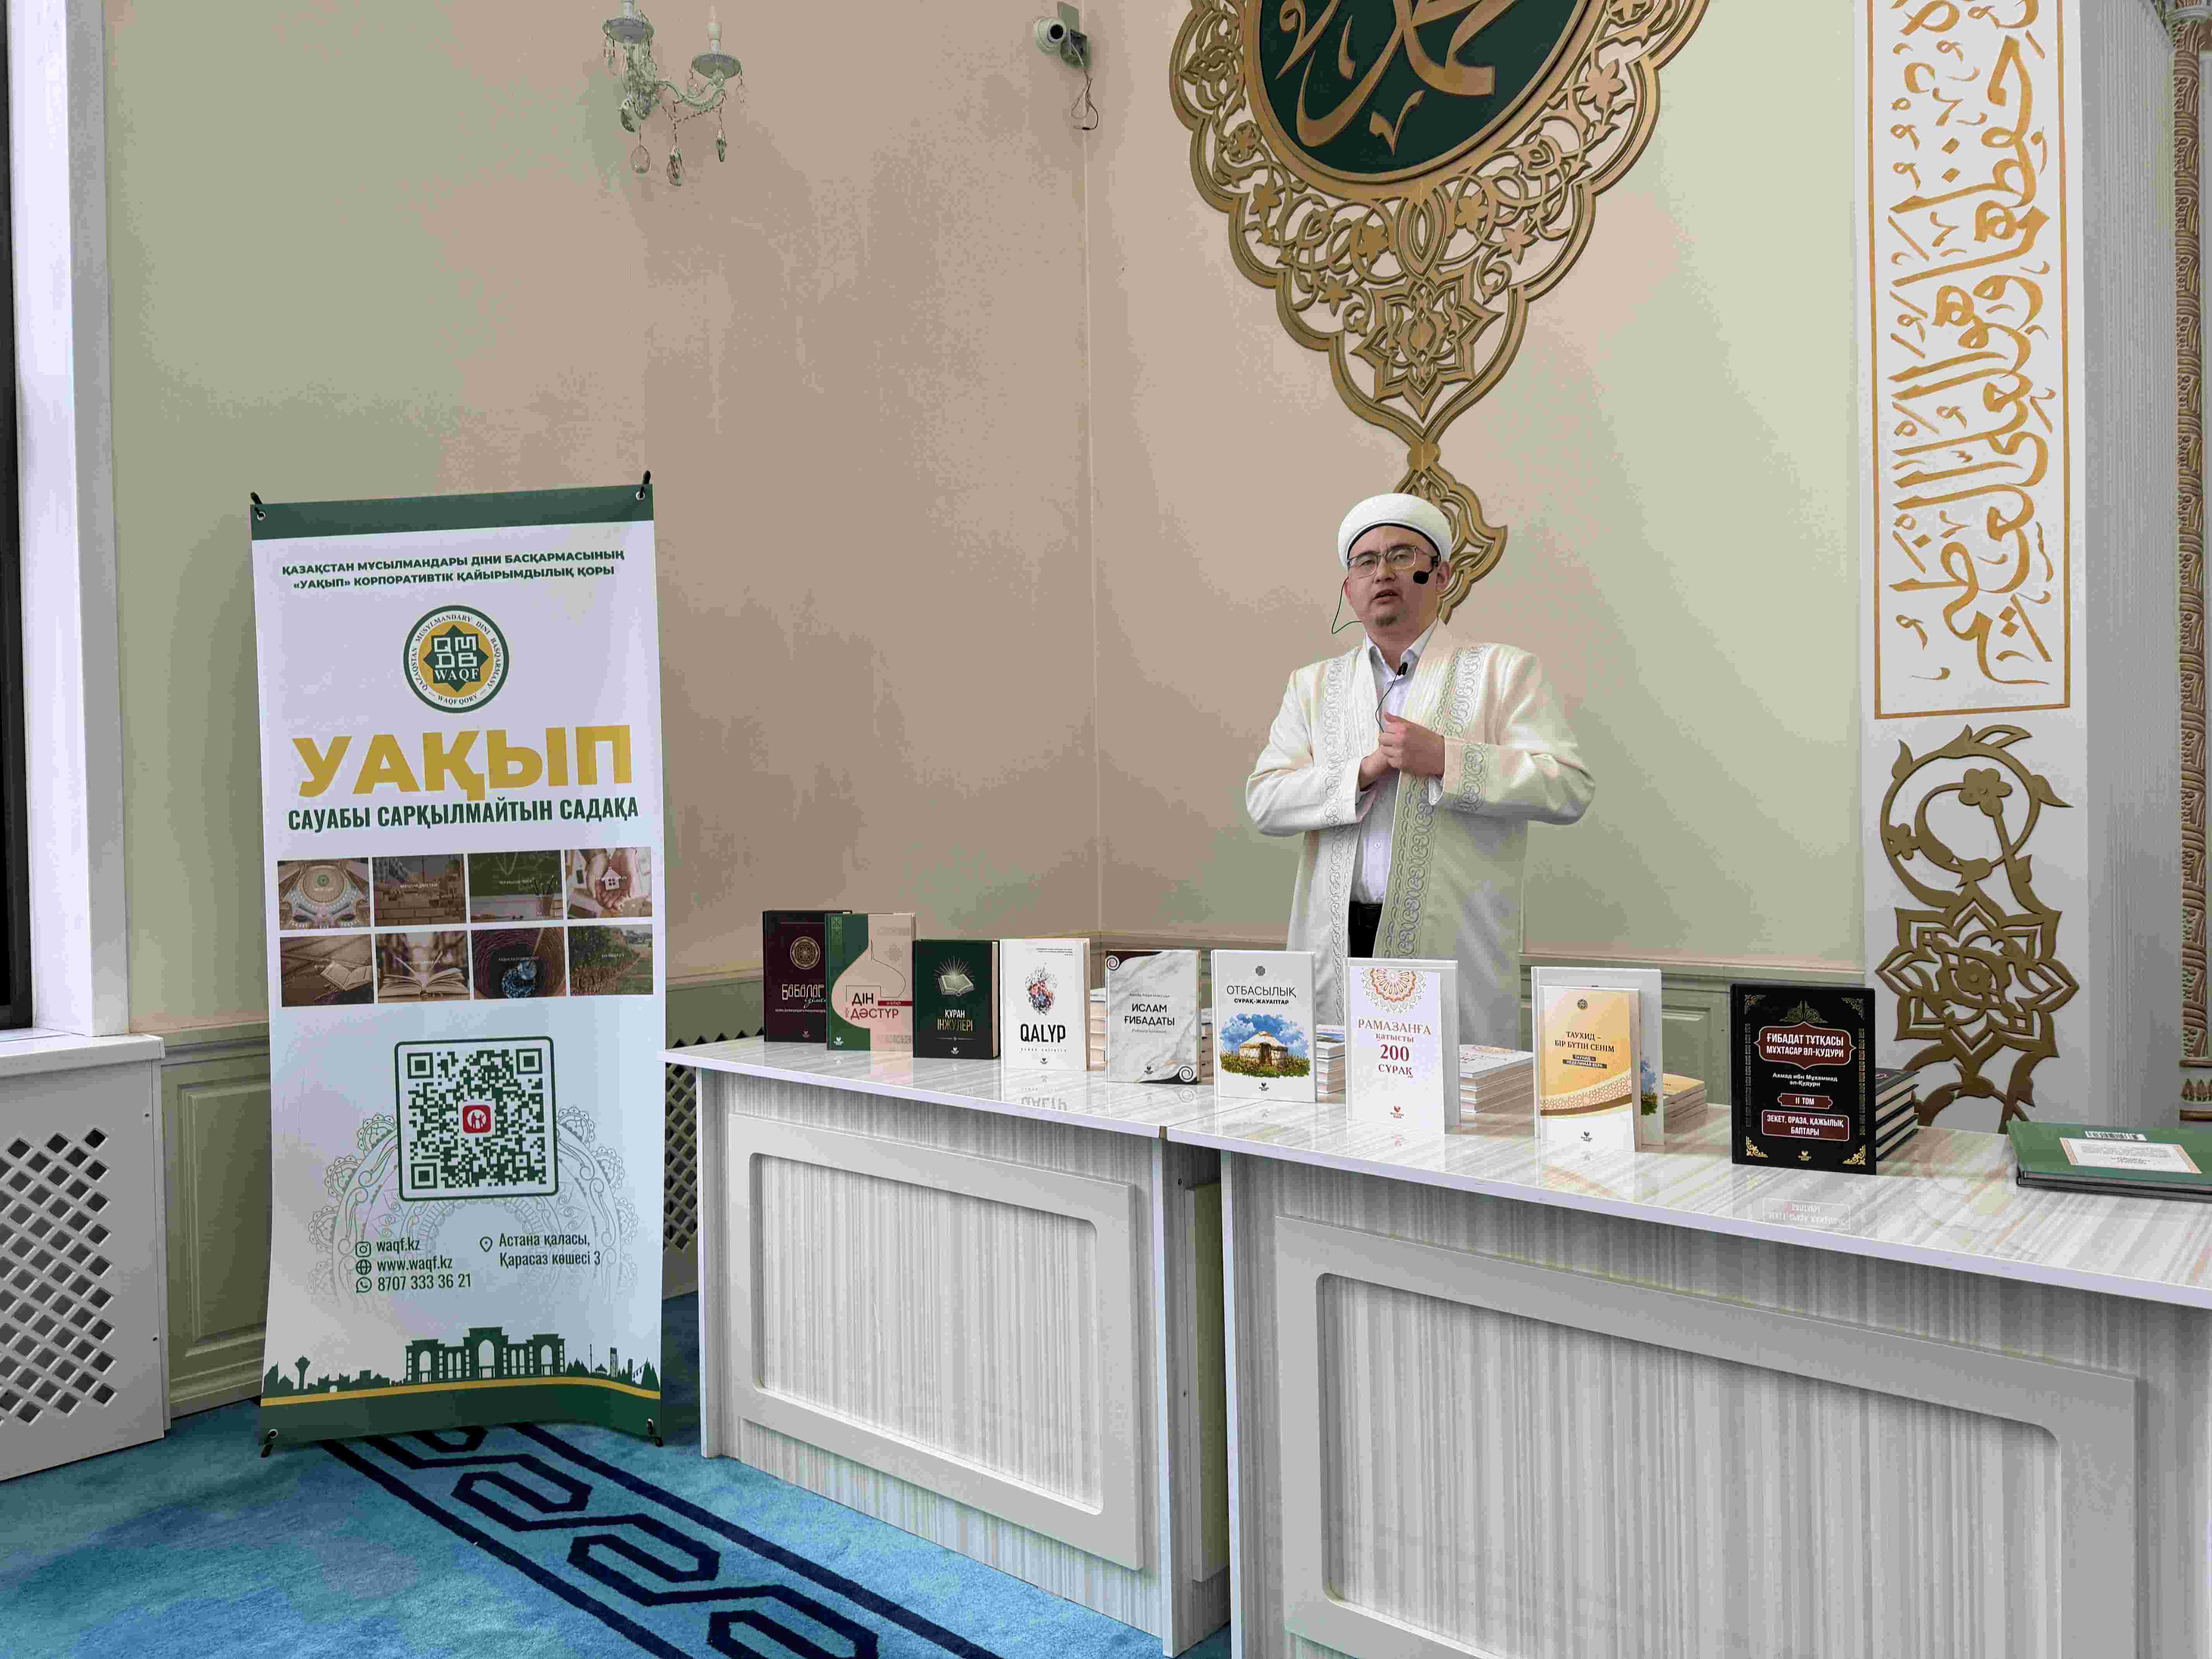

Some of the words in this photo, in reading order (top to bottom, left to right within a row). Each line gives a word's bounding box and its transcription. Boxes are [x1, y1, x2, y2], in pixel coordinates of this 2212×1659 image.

[282, 563, 354, 575] ҚАЗАҚСТАН
[358, 556, 467, 571] МҰСЫЛМАНДАРЫ
[471, 555, 501, 567] ДІНИ
[505, 550, 625, 564] БАСҚАРМАСЫНЫҢ
[294, 578, 350, 589] «УАҚЫП»
[354, 573, 453, 586] КОРПОРАТИВТІК
[457, 567, 574, 582] ҚАЙЫРЫМДЫЛЫҚ
[578, 566, 615, 577] ҚОРЫ
[476, 621, 491, 635] DINI
[434, 668, 479, 682] WAQF
[438, 694, 457, 704] WAQF
[292, 725, 632, 801] УАҚЫП
[289, 807, 371, 833] САУАБЫ
[378, 797, 553, 830] САРҚЫЛМАЙТЫН
[560, 796, 639, 821] САДАҚА
[1227, 985, 1296, 998] ОТБАСЫЛЫҚ
[852, 992, 874, 1006] ДІН
[850, 1008, 899, 1020] ДӘСТҮР
[1132, 1003, 1167, 1013] ИСЛАМ
[1124, 1015, 1175, 1027] ҒИБАДАТЫ
[1358, 1019, 1431, 1035] РАМАЗАНҒА
[1020, 1024, 1066, 1043] QALYP
[1566, 1031, 1595, 1041] ТАУХИД
[1767, 1033, 1803, 1044] ҒИБАДАТ
[1805, 1035, 1843, 1046] ТҰТҚАСЫ
[1380, 1044, 1409, 1061] 200
[1590, 1044, 1614, 1053] СЕНІМ
[1766, 1046, 1802, 1055] МҰХТАСАР
[1767, 1115, 1786, 1123] ЗЕКЕТ,
[1810, 1117, 1844, 1128] ҚАЖЫЛЫҚ
[1791, 1127, 1819, 1136] БАПТАРЫ
[376, 1238, 420, 1255] waqf.kz
[499, 1233, 540, 1247] Астана
[544, 1233, 591, 1248] қаласы,
[377, 1256, 453, 1272] www.waqf.kz
[500, 1252, 548, 1269] Қарасаз
[552, 1251, 590, 1265] көшесі
[594, 1251, 601, 1265] 3
[378, 1276, 406, 1291] 8707
[411, 1275, 434, 1290] 333
[438, 1274, 454, 1288] 36
[458, 1273, 471, 1288] 21
